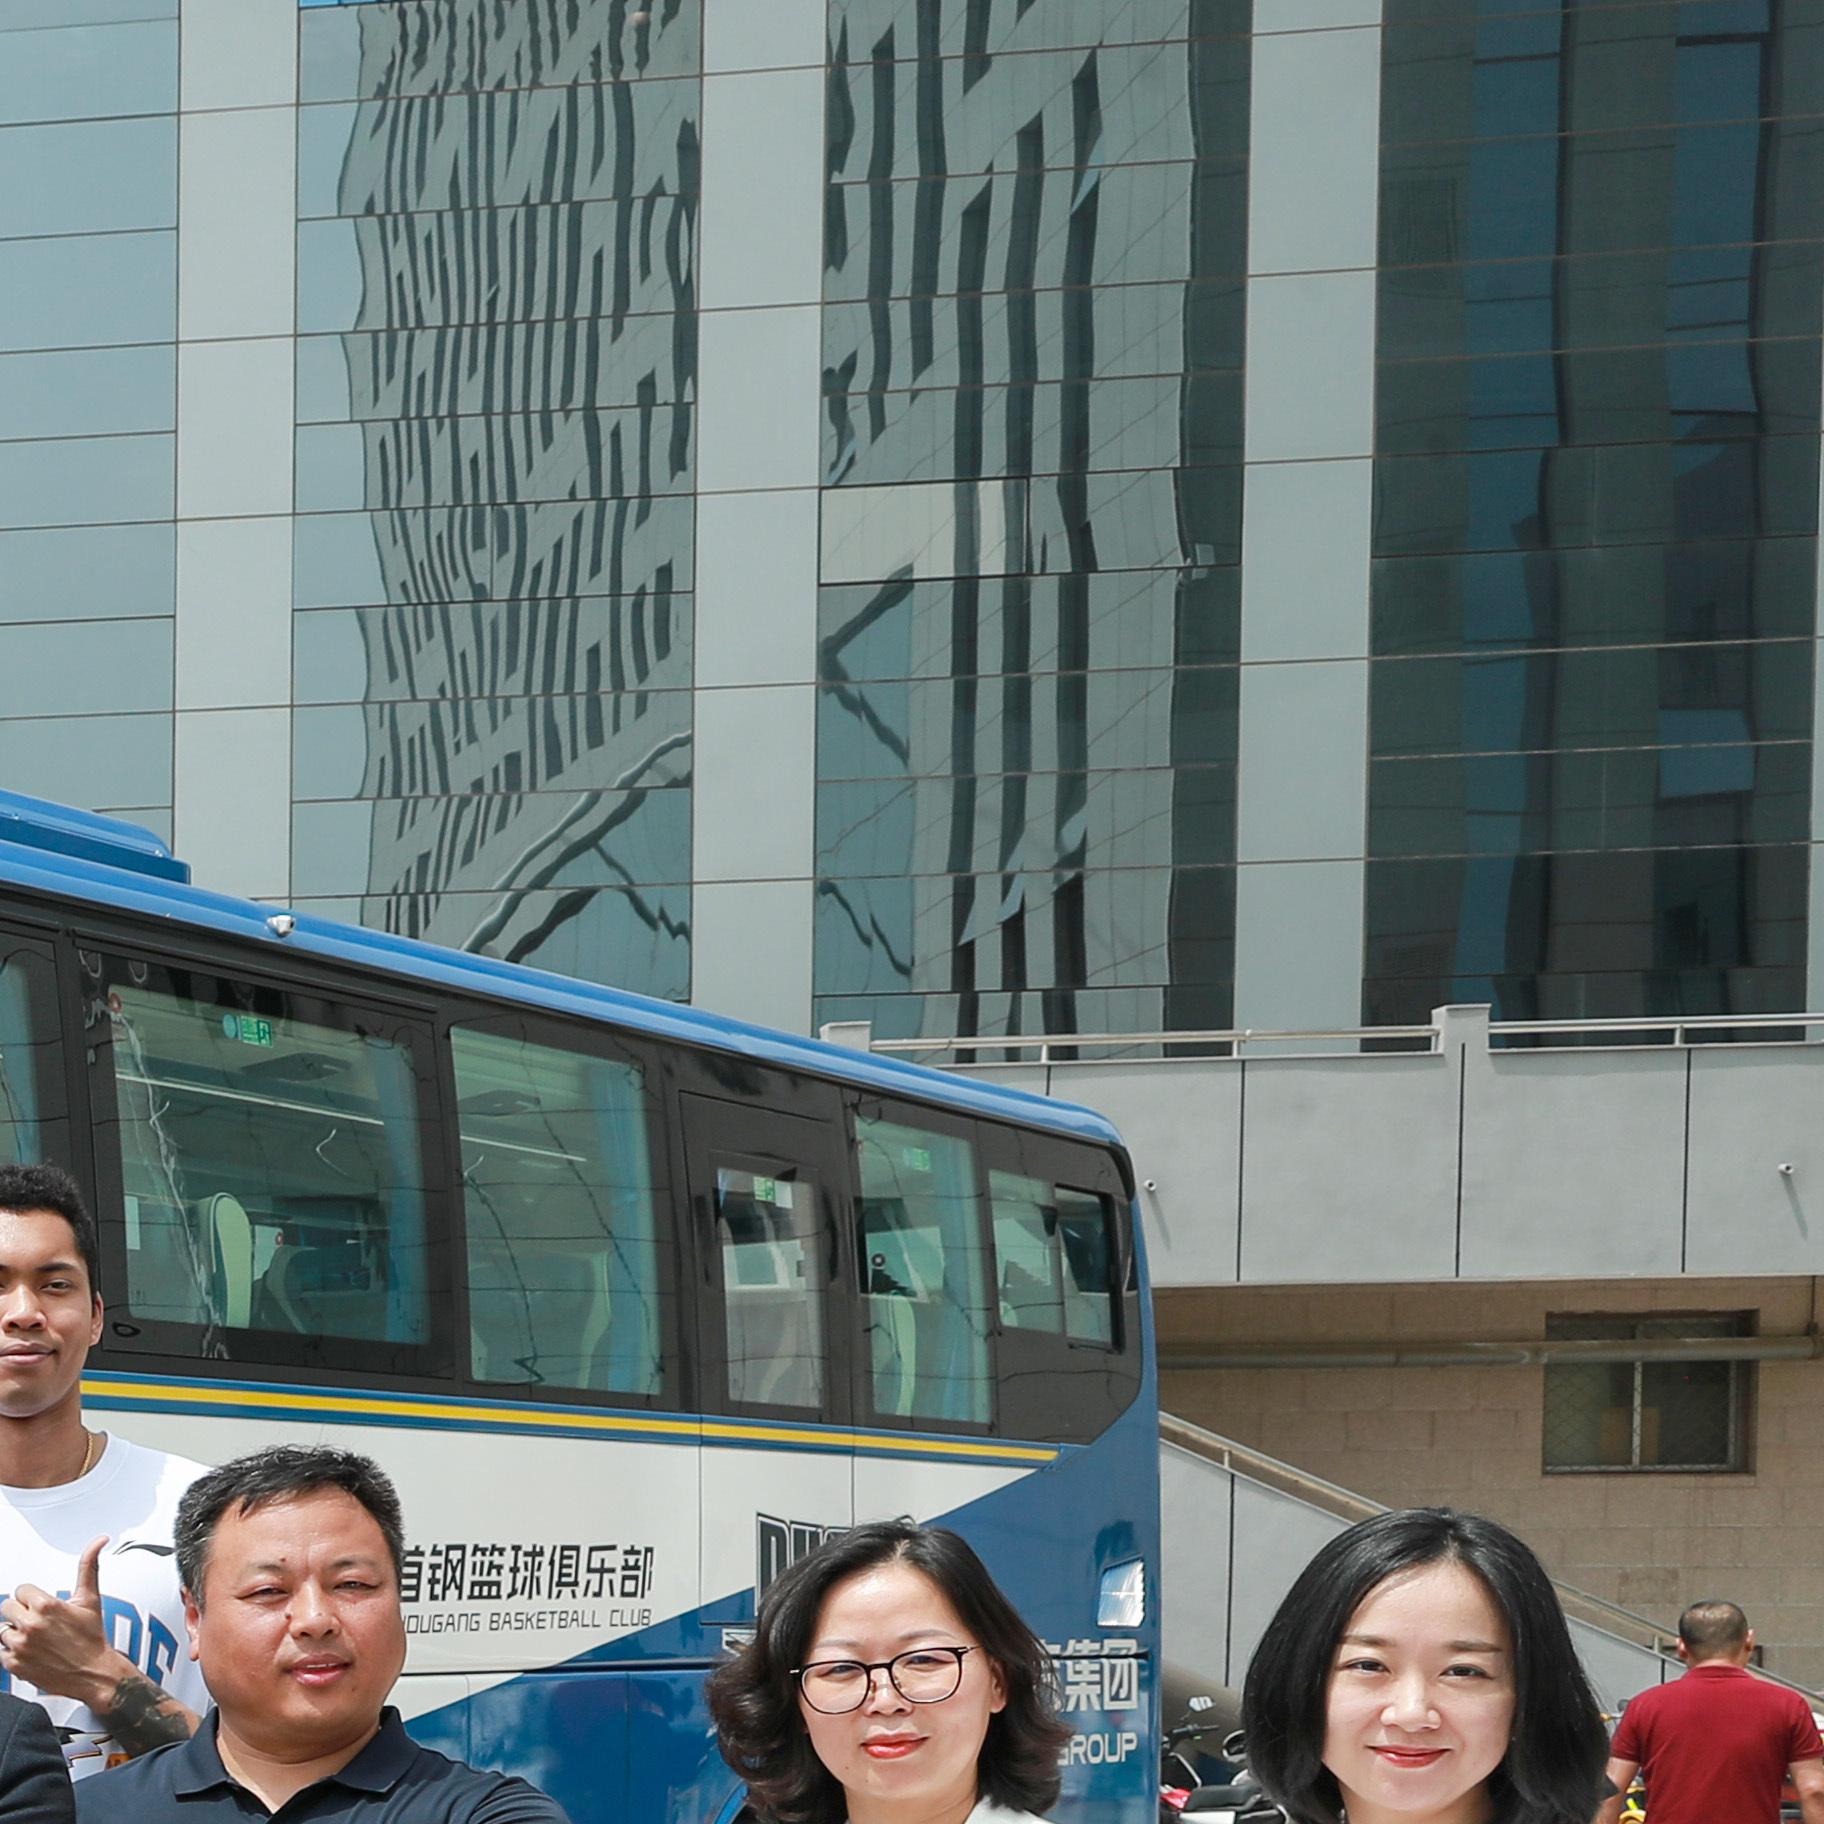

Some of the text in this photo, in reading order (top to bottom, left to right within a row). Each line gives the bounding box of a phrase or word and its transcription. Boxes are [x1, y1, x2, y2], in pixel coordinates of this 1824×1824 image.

[403, 1607, 653, 1634] OUGANG BASKETBALL CLUB
